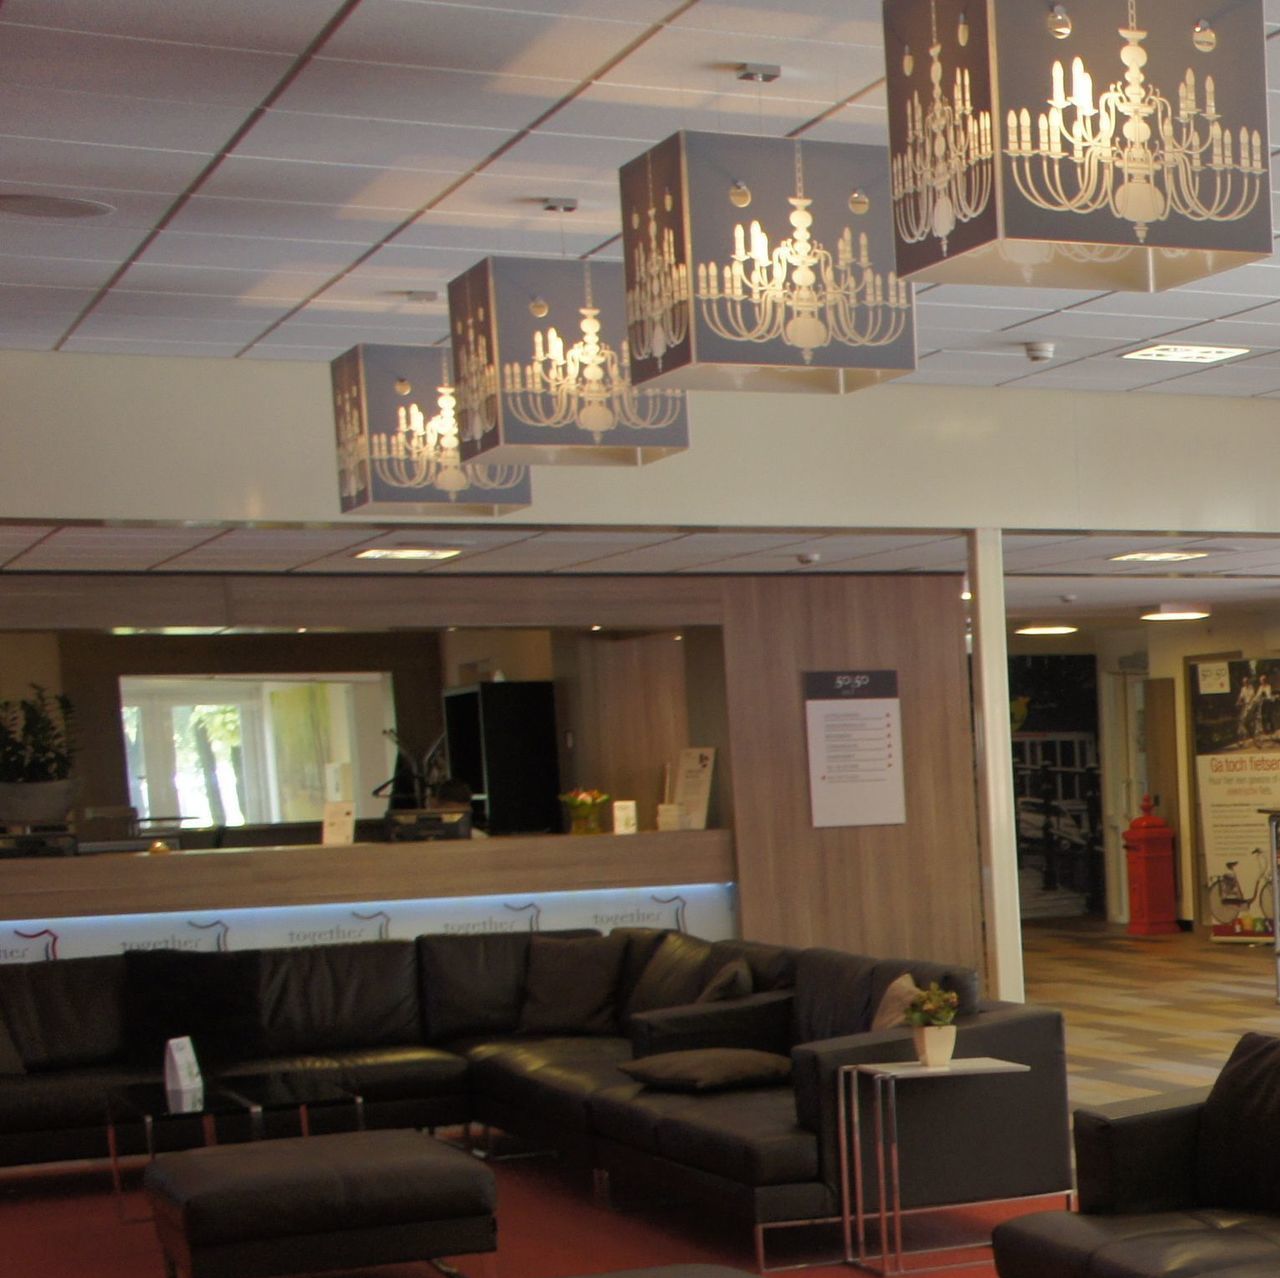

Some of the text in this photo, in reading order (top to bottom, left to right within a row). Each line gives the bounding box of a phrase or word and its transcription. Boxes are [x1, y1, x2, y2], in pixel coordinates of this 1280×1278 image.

[1210, 757, 1223, 773] Ga
[1225, 756, 1248, 772] toch
[592, 909, 664, 928] together
[288, 925, 366, 945] together
